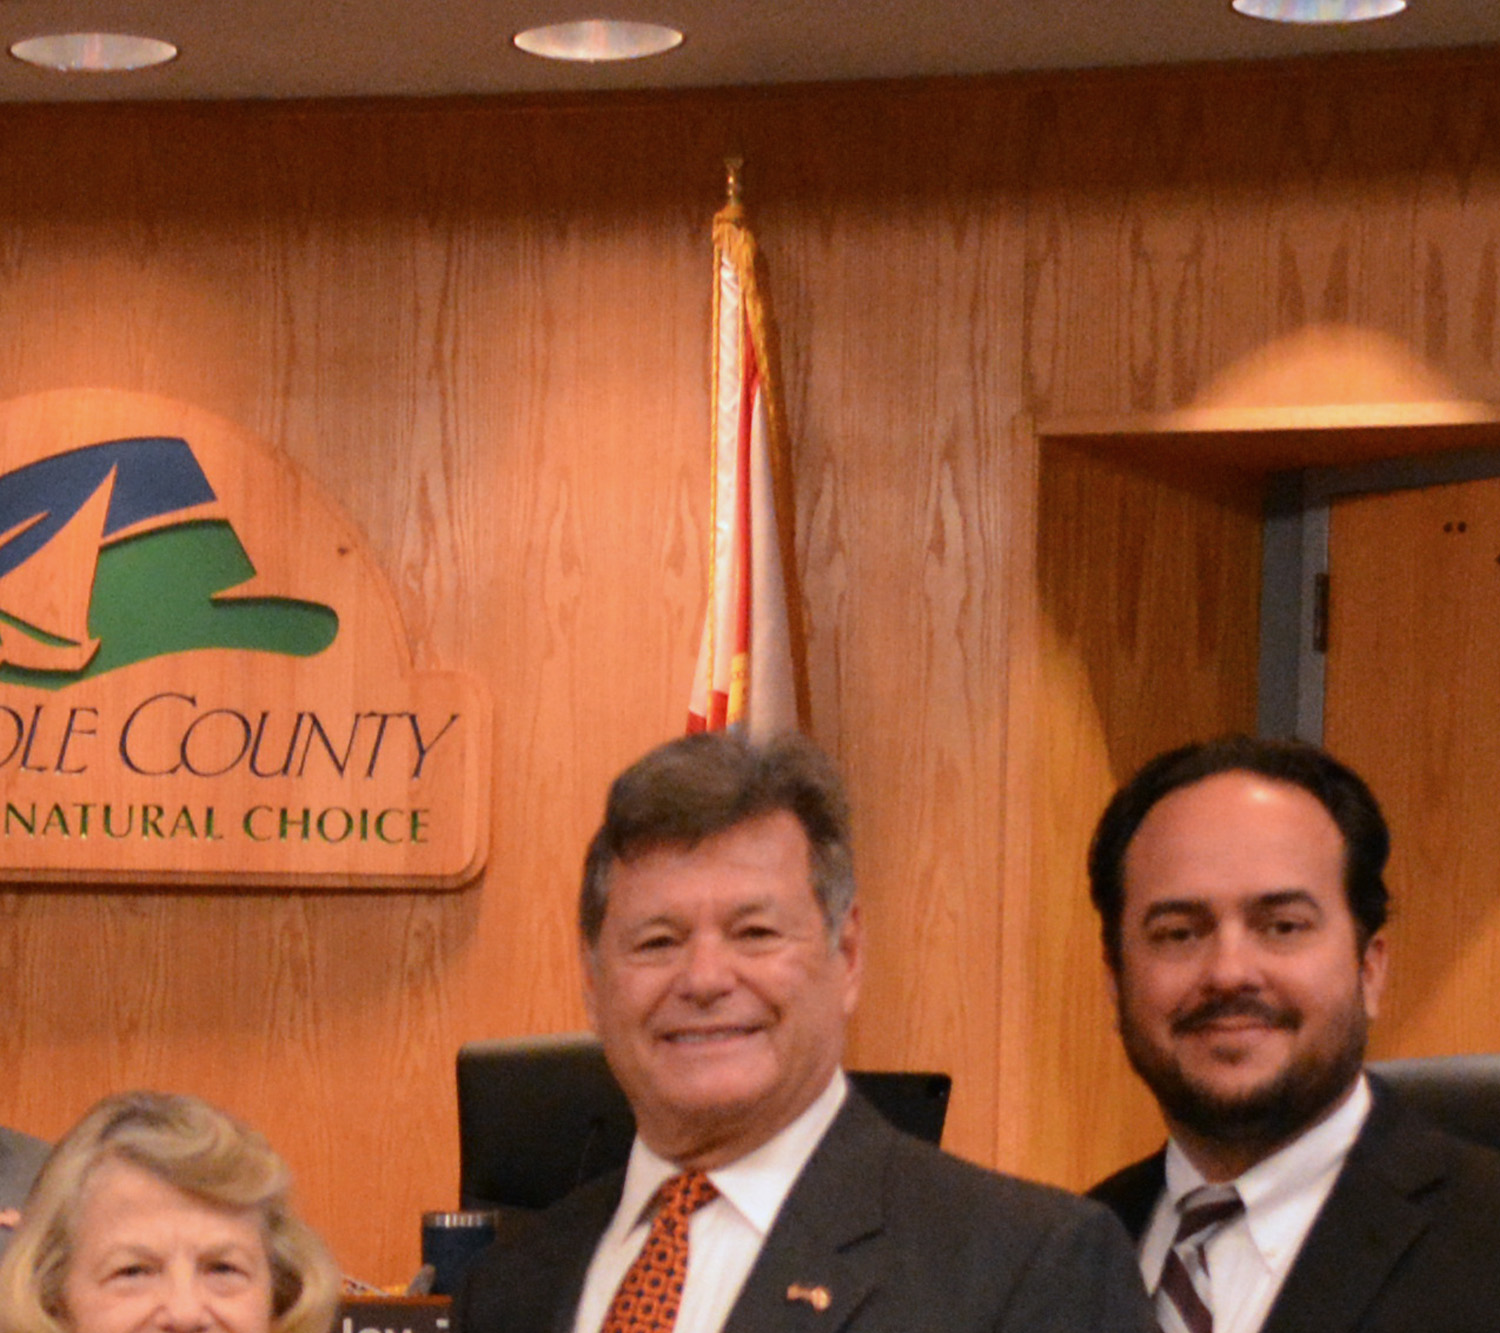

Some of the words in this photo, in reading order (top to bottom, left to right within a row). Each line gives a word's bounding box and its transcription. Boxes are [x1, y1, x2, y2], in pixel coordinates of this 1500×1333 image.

[118, 691, 460, 779] COUNTY
[4, 802, 225, 841] NATURAL
[242, 804, 431, 844] CHOICE
